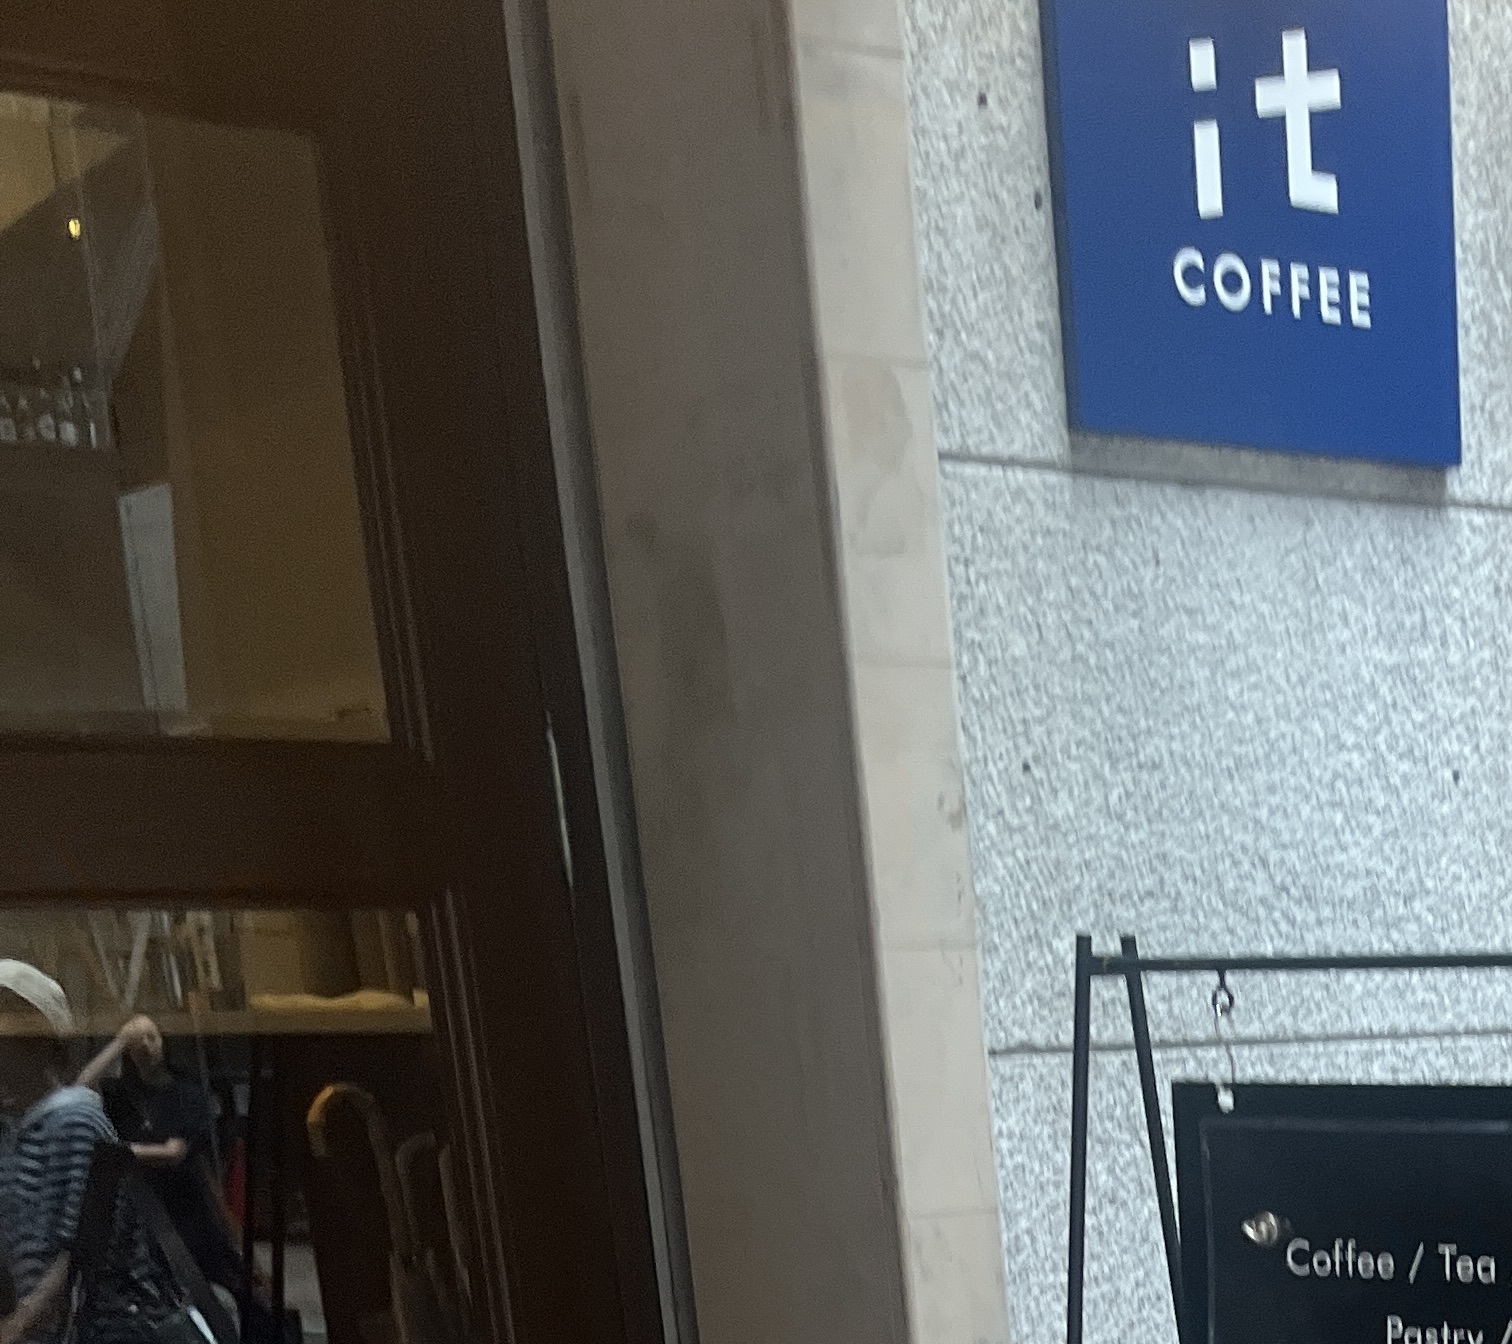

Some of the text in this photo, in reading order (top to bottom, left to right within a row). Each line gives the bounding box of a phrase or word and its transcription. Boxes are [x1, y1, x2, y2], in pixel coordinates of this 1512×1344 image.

[1189, 28, 1342, 220] it
[1172, 246, 1372, 330] COFFEE
[1285, 1238, 1395, 1281] Coffee
[1437, 1242, 1497, 1285] Tea
